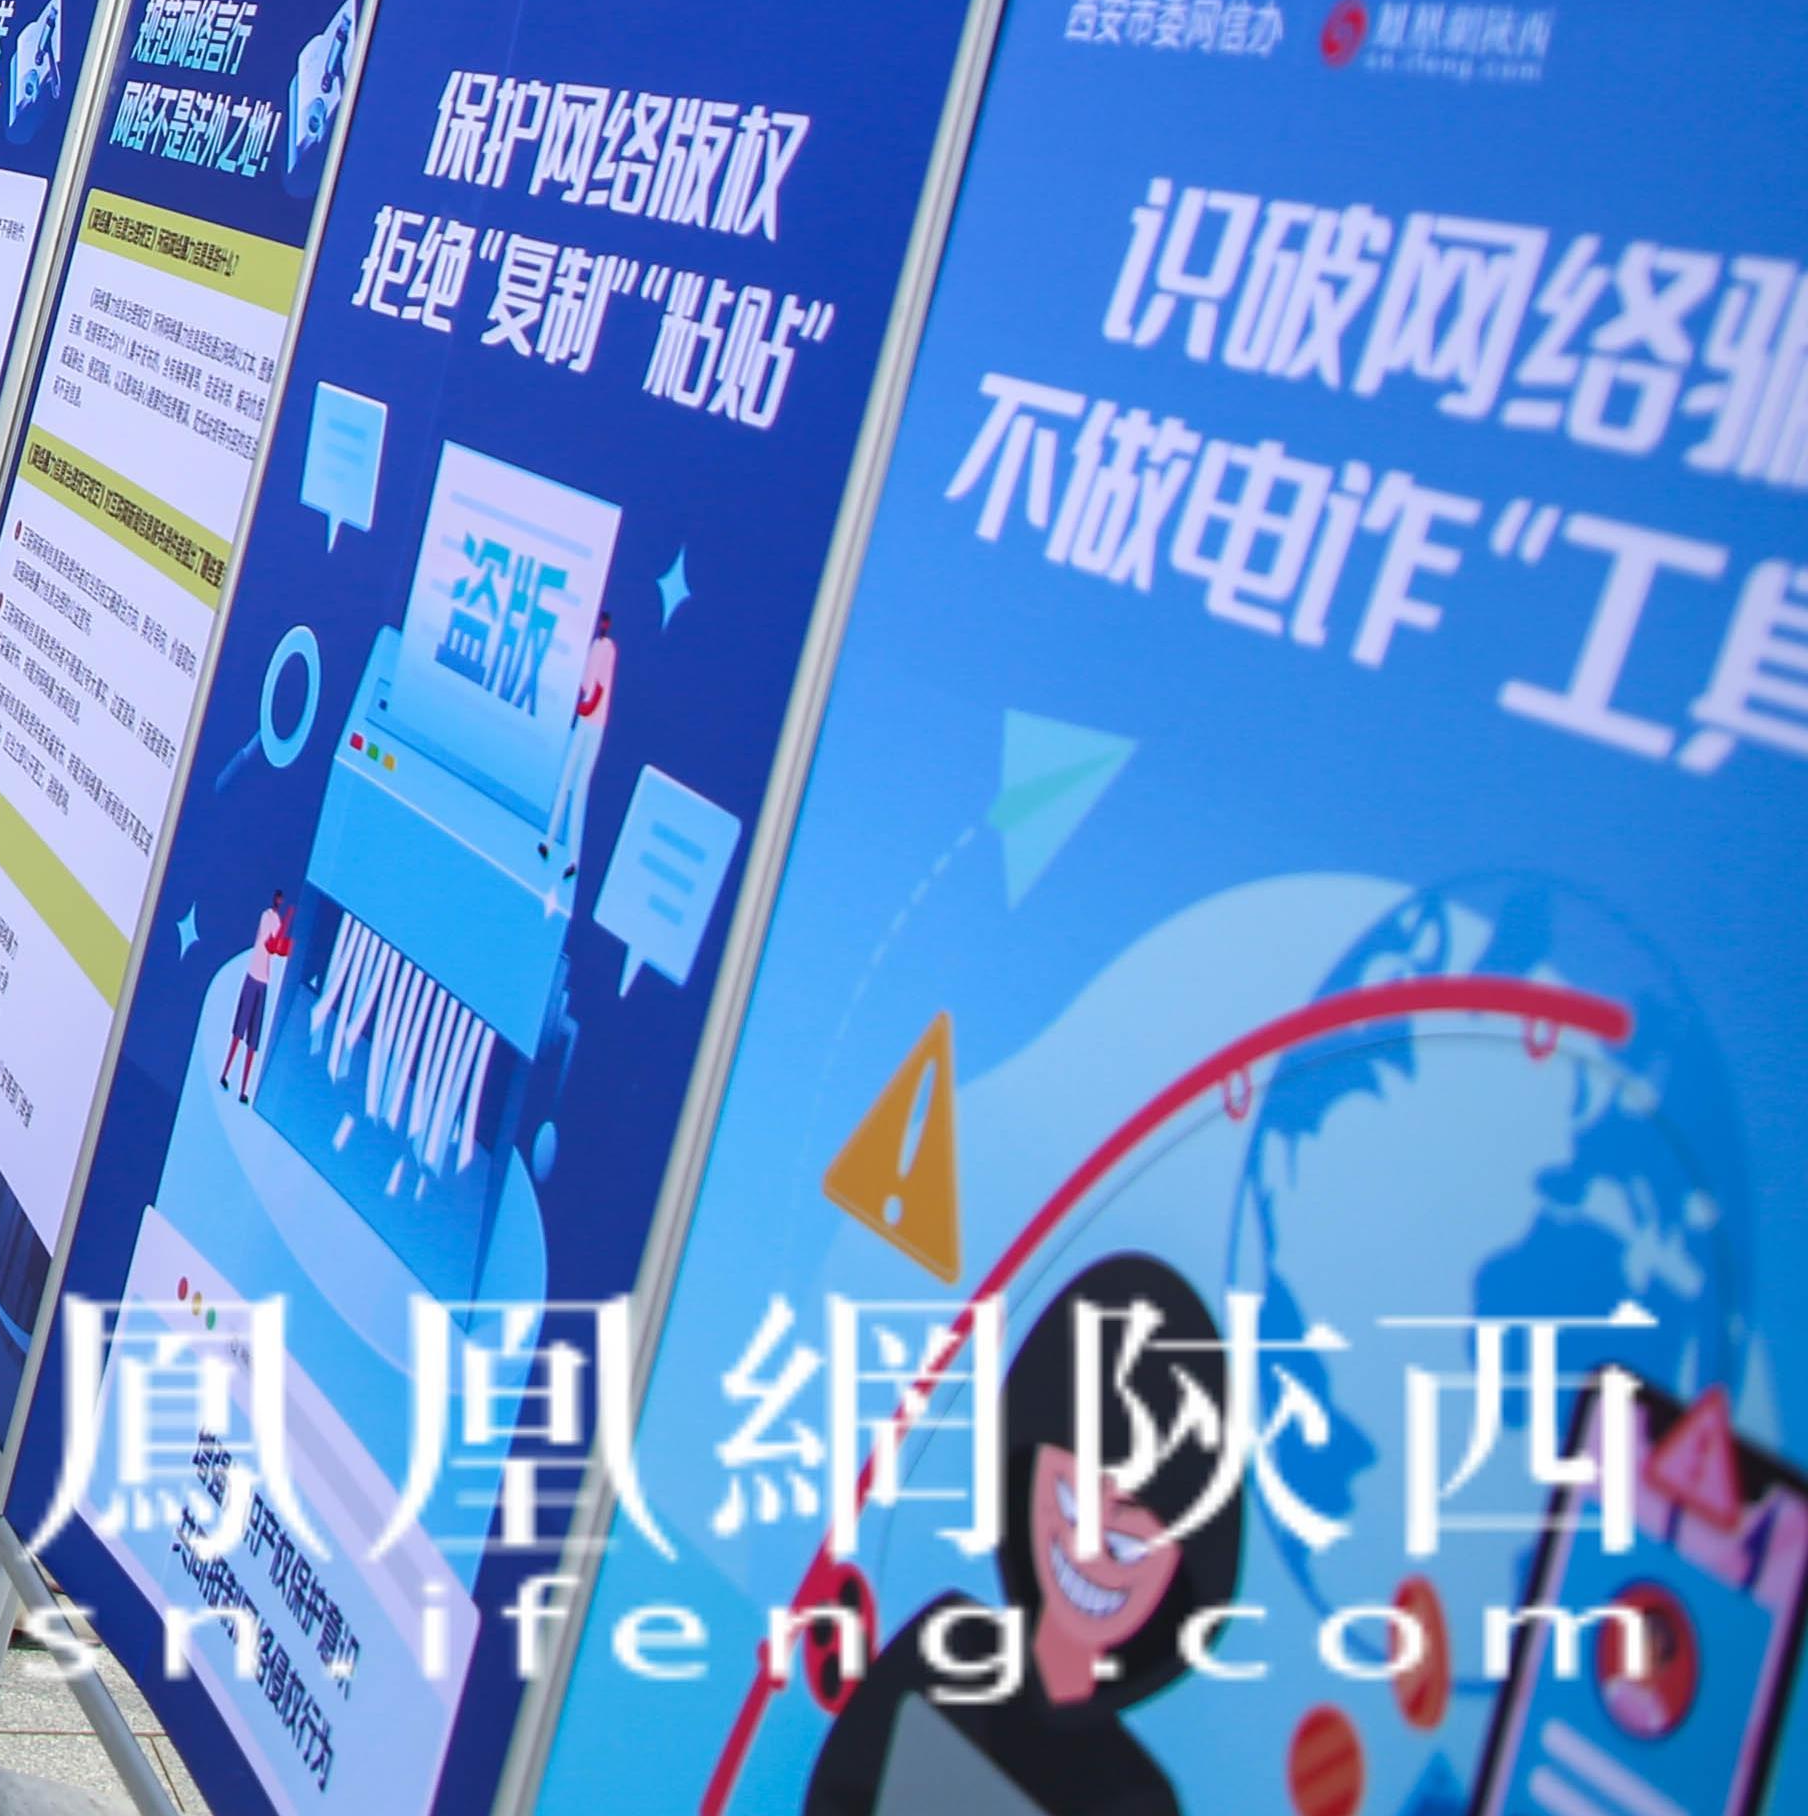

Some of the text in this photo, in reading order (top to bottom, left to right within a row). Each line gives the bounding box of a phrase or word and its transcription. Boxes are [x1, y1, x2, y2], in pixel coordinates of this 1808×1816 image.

[109, 80, 282, 177] 网络不是法外之地！
[422, 69, 810, 242] 保护网络版权
[434, 529, 568, 717] 盗版
[192, 1423, 363, 1701] 增强识产权保护意识
